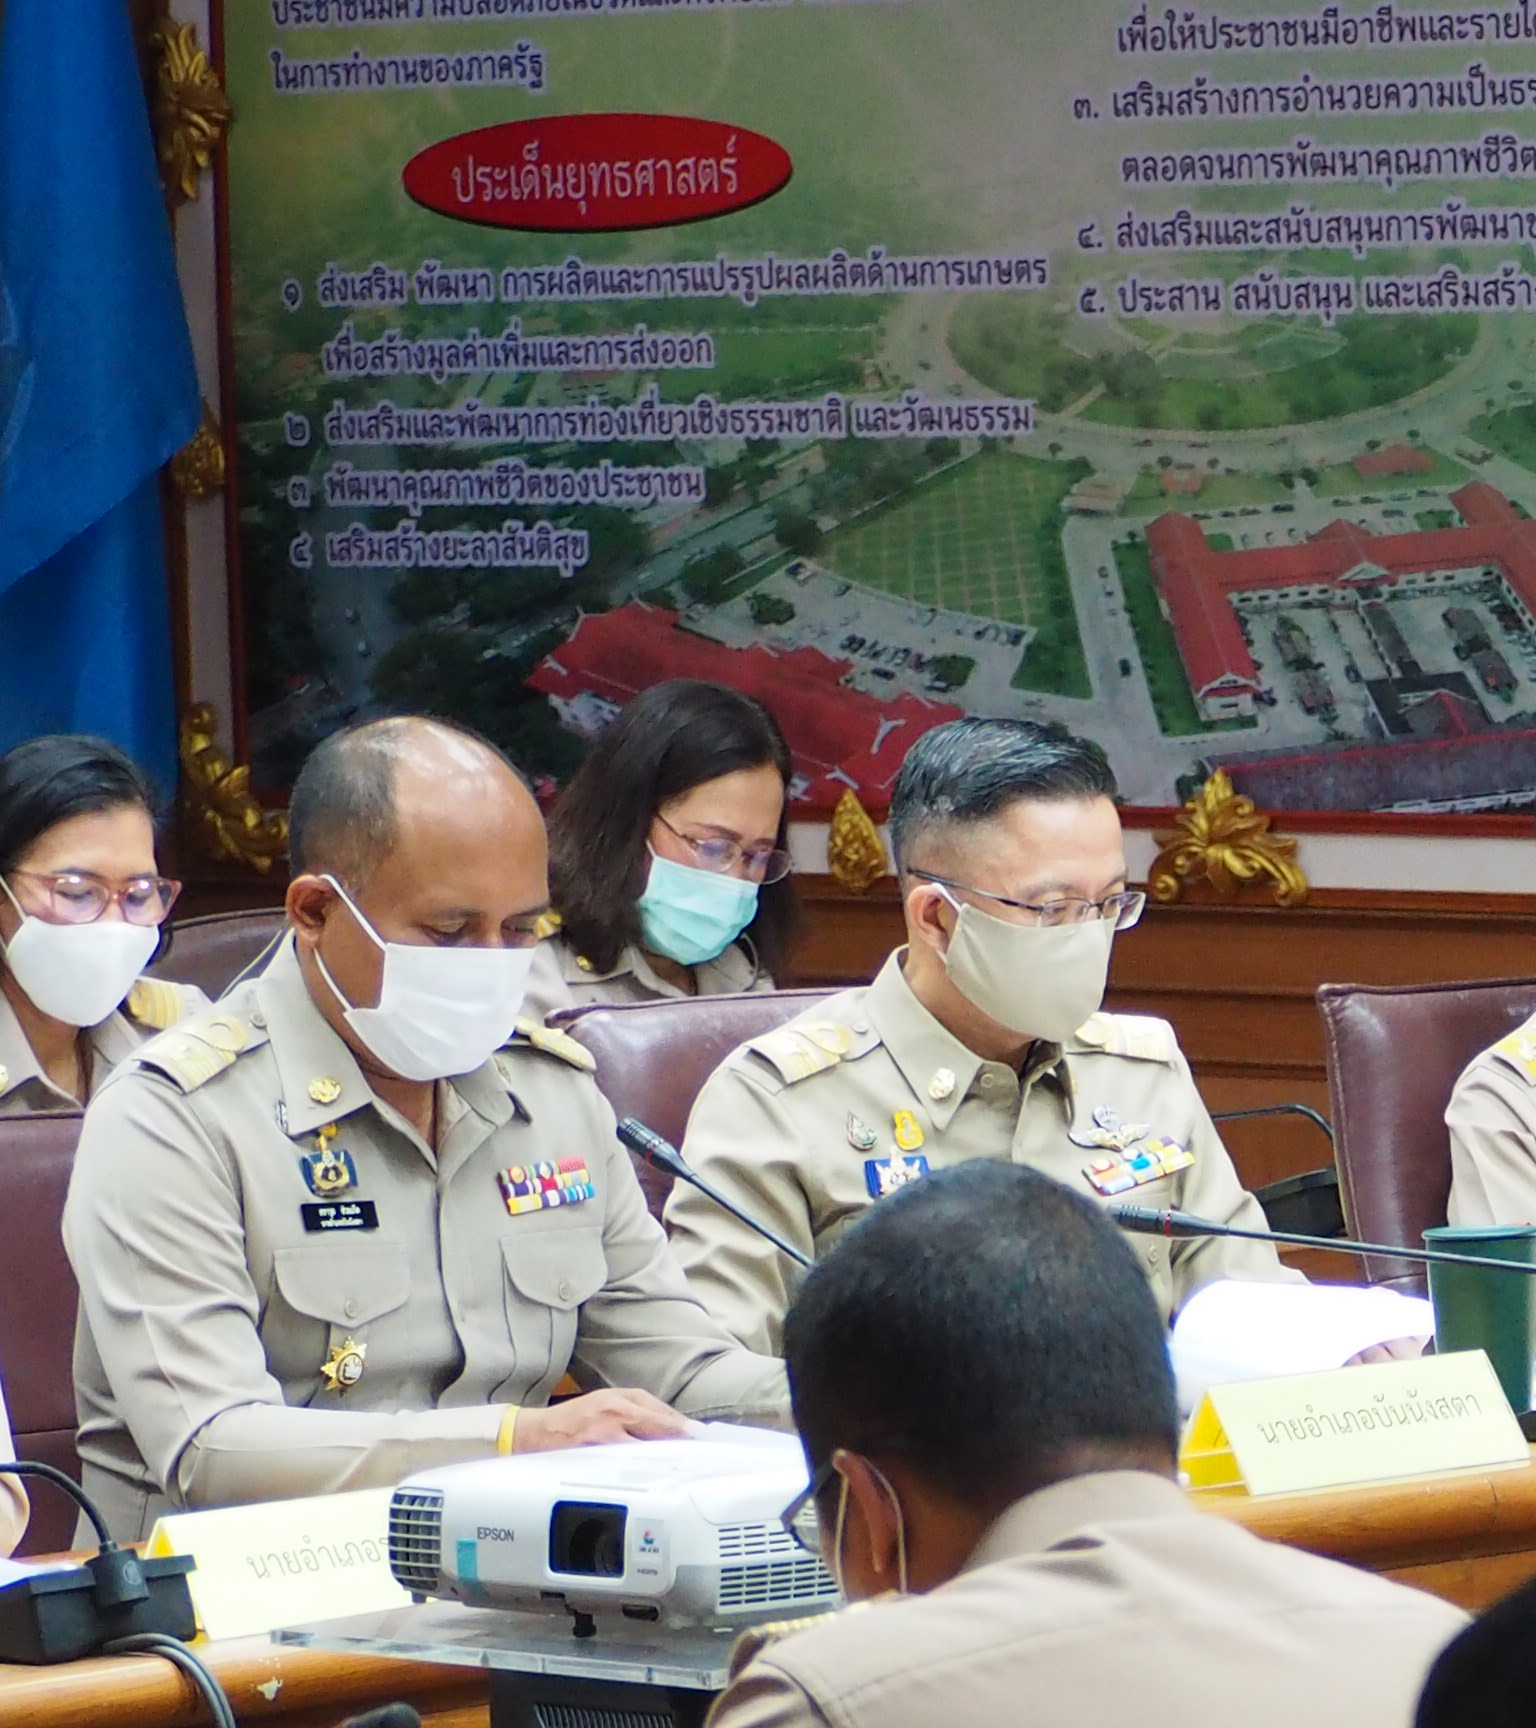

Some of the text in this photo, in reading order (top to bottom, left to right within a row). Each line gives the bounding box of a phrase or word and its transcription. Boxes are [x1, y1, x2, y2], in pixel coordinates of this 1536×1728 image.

[270, 44, 544, 90] ในการทำงานของภาครัฐ
[451, 135, 739, 215] ประเด็นยุทธศาสตร์
[319, 264, 405, 301] ส่งเสริม
[414, 264, 491, 299] พัฒนา
[502, 250, 1048, 303] การผลิตและการแปรรูปผลผลิตด้านการเกษตร
[1117, 279, 1221, 313] ประสาน
[1233, 273, 1352, 322] สนับสนุน
[324, 321, 713, 380] เพื่อสร้างมูลค่าเพิ่มและการส่งออก
[327, 388, 844, 442] ส่งเสริมและพัฒนาการท่องเที่ยวเชิงธรรมชาติ
[855, 393, 1031, 433] และวัฒนธรรม
[326, 459, 702, 513] พัฒนาคุณภาพชีวิตของประชาชน
[327, 524, 587, 575] เสริมสร้างยะลาสันติสุข
[1256, 1388, 1484, 1445] นายอำเภอบันนังสตา
[245, 1534, 390, 1579] นายอำเภอ
[477, 1526, 515, 1542] EPSON
